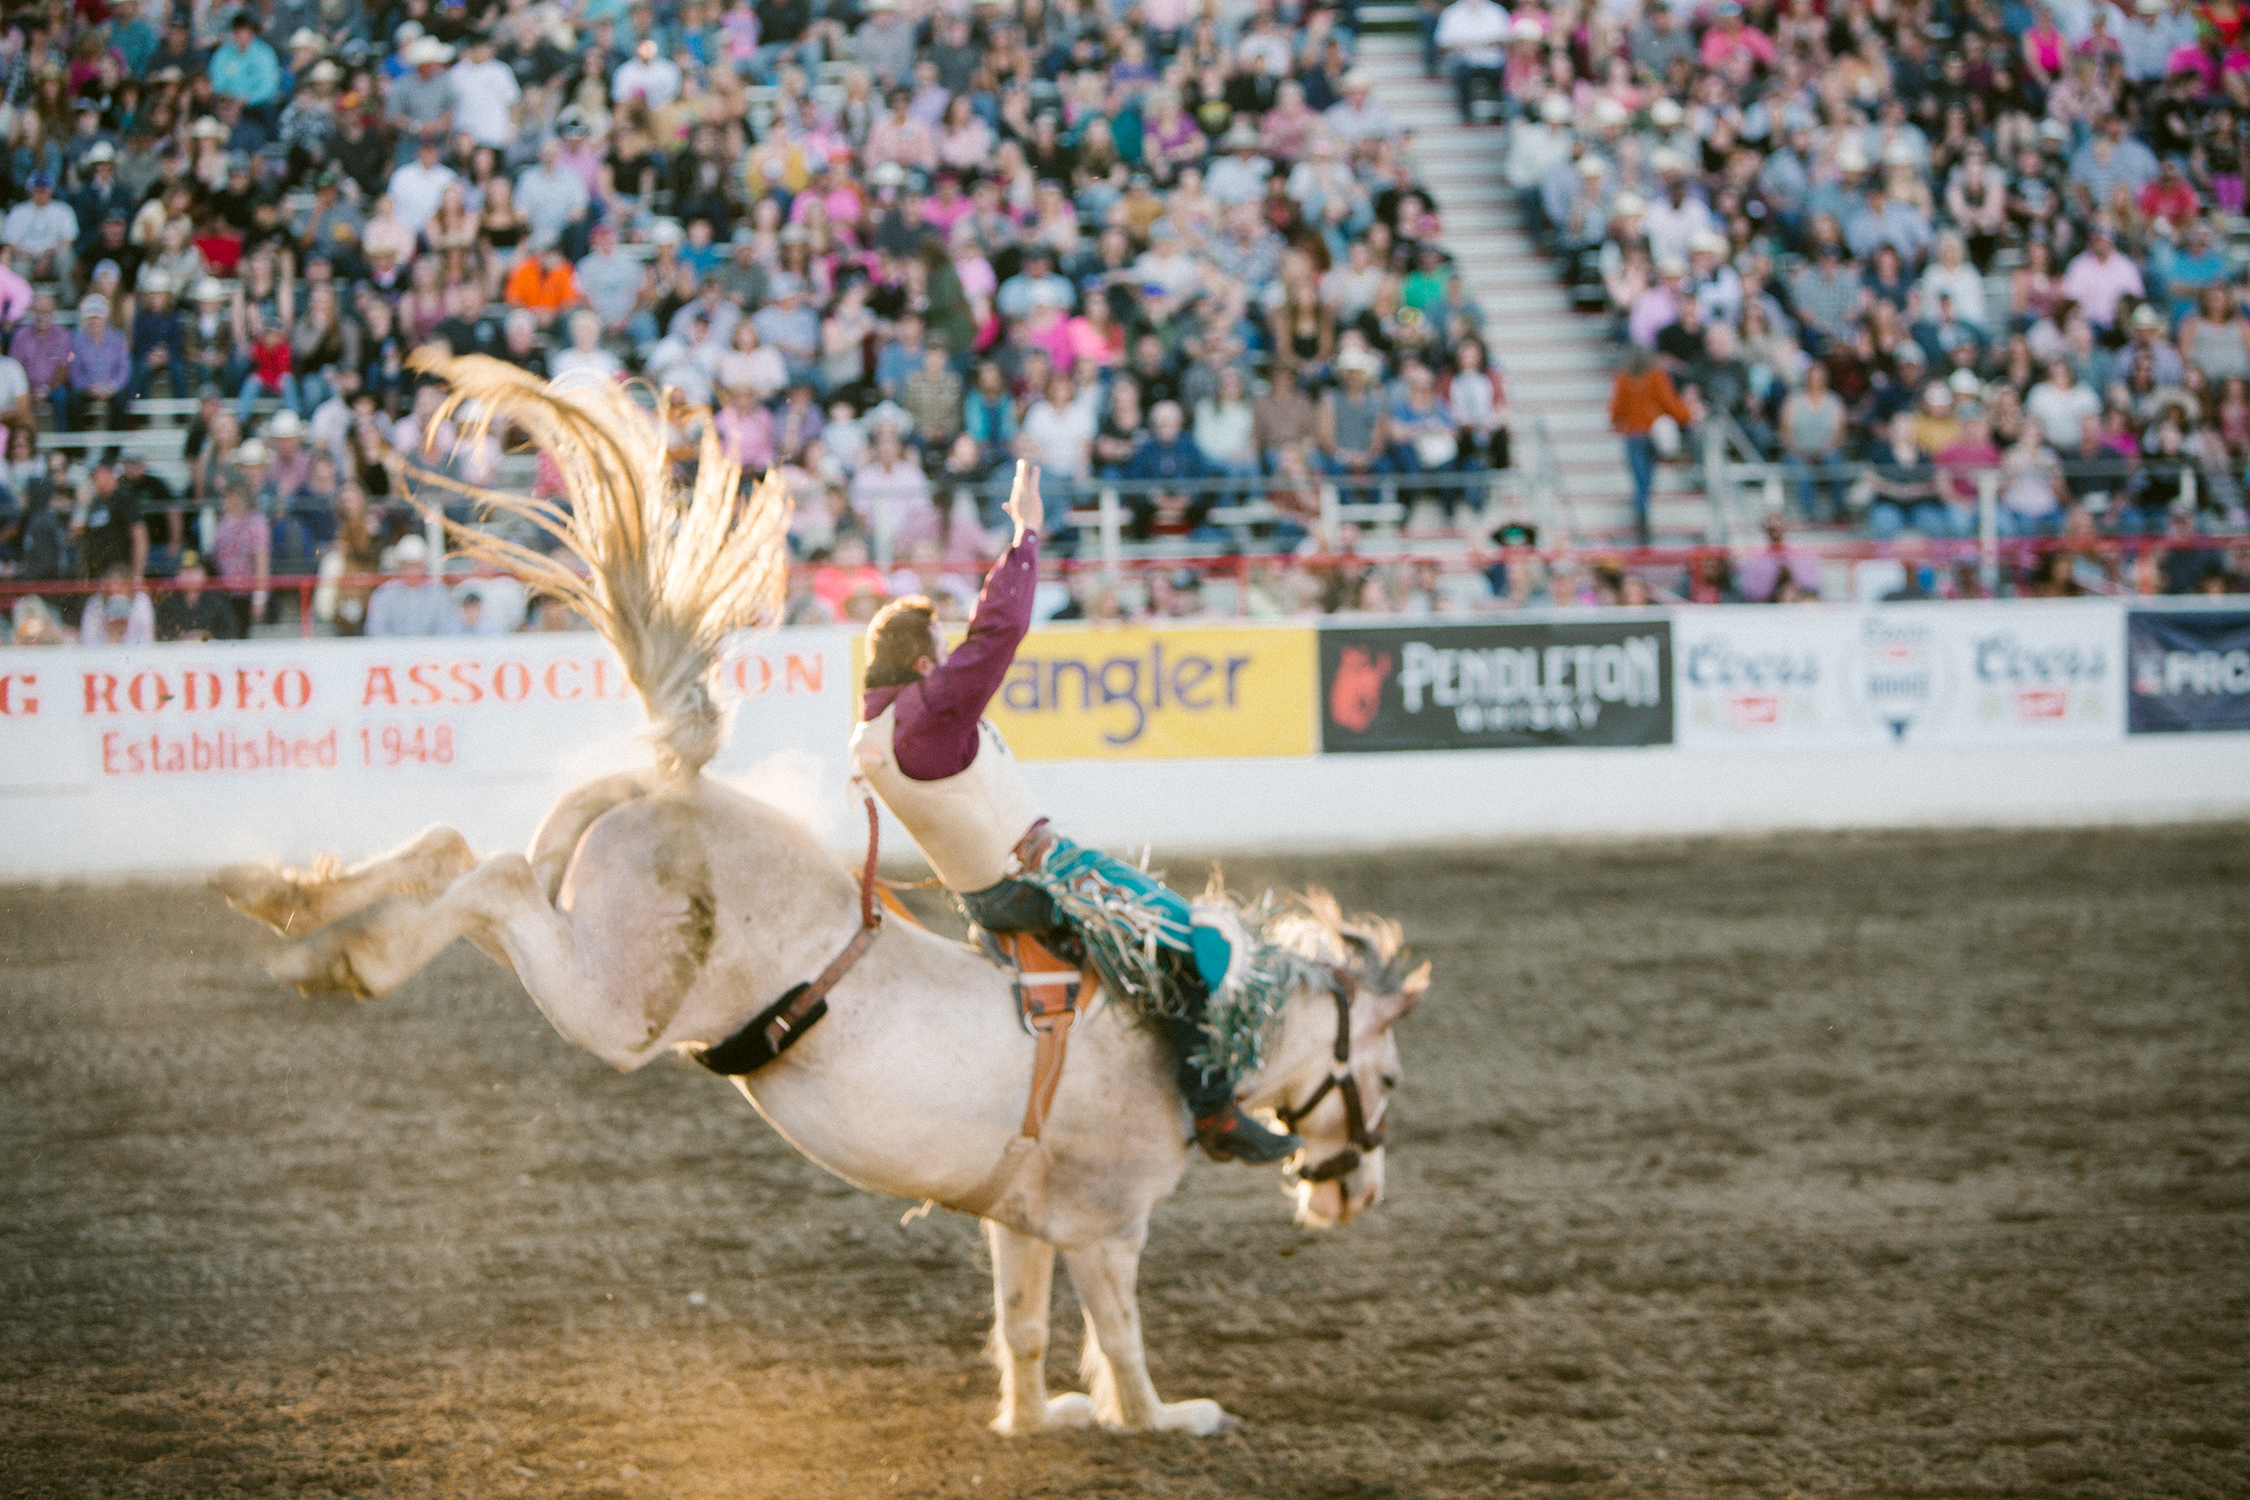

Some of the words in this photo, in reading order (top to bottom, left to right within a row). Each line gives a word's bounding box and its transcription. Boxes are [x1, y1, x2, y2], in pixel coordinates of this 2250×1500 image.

[82, 667, 311, 713] RODEO
[362, 653, 822, 706] ASSOCION
[1004, 642, 1252, 745] angler
[1399, 636, 1660, 713] PENDLETON
[102, 728, 338, 774] Established
[360, 724, 455, 767] 1948
